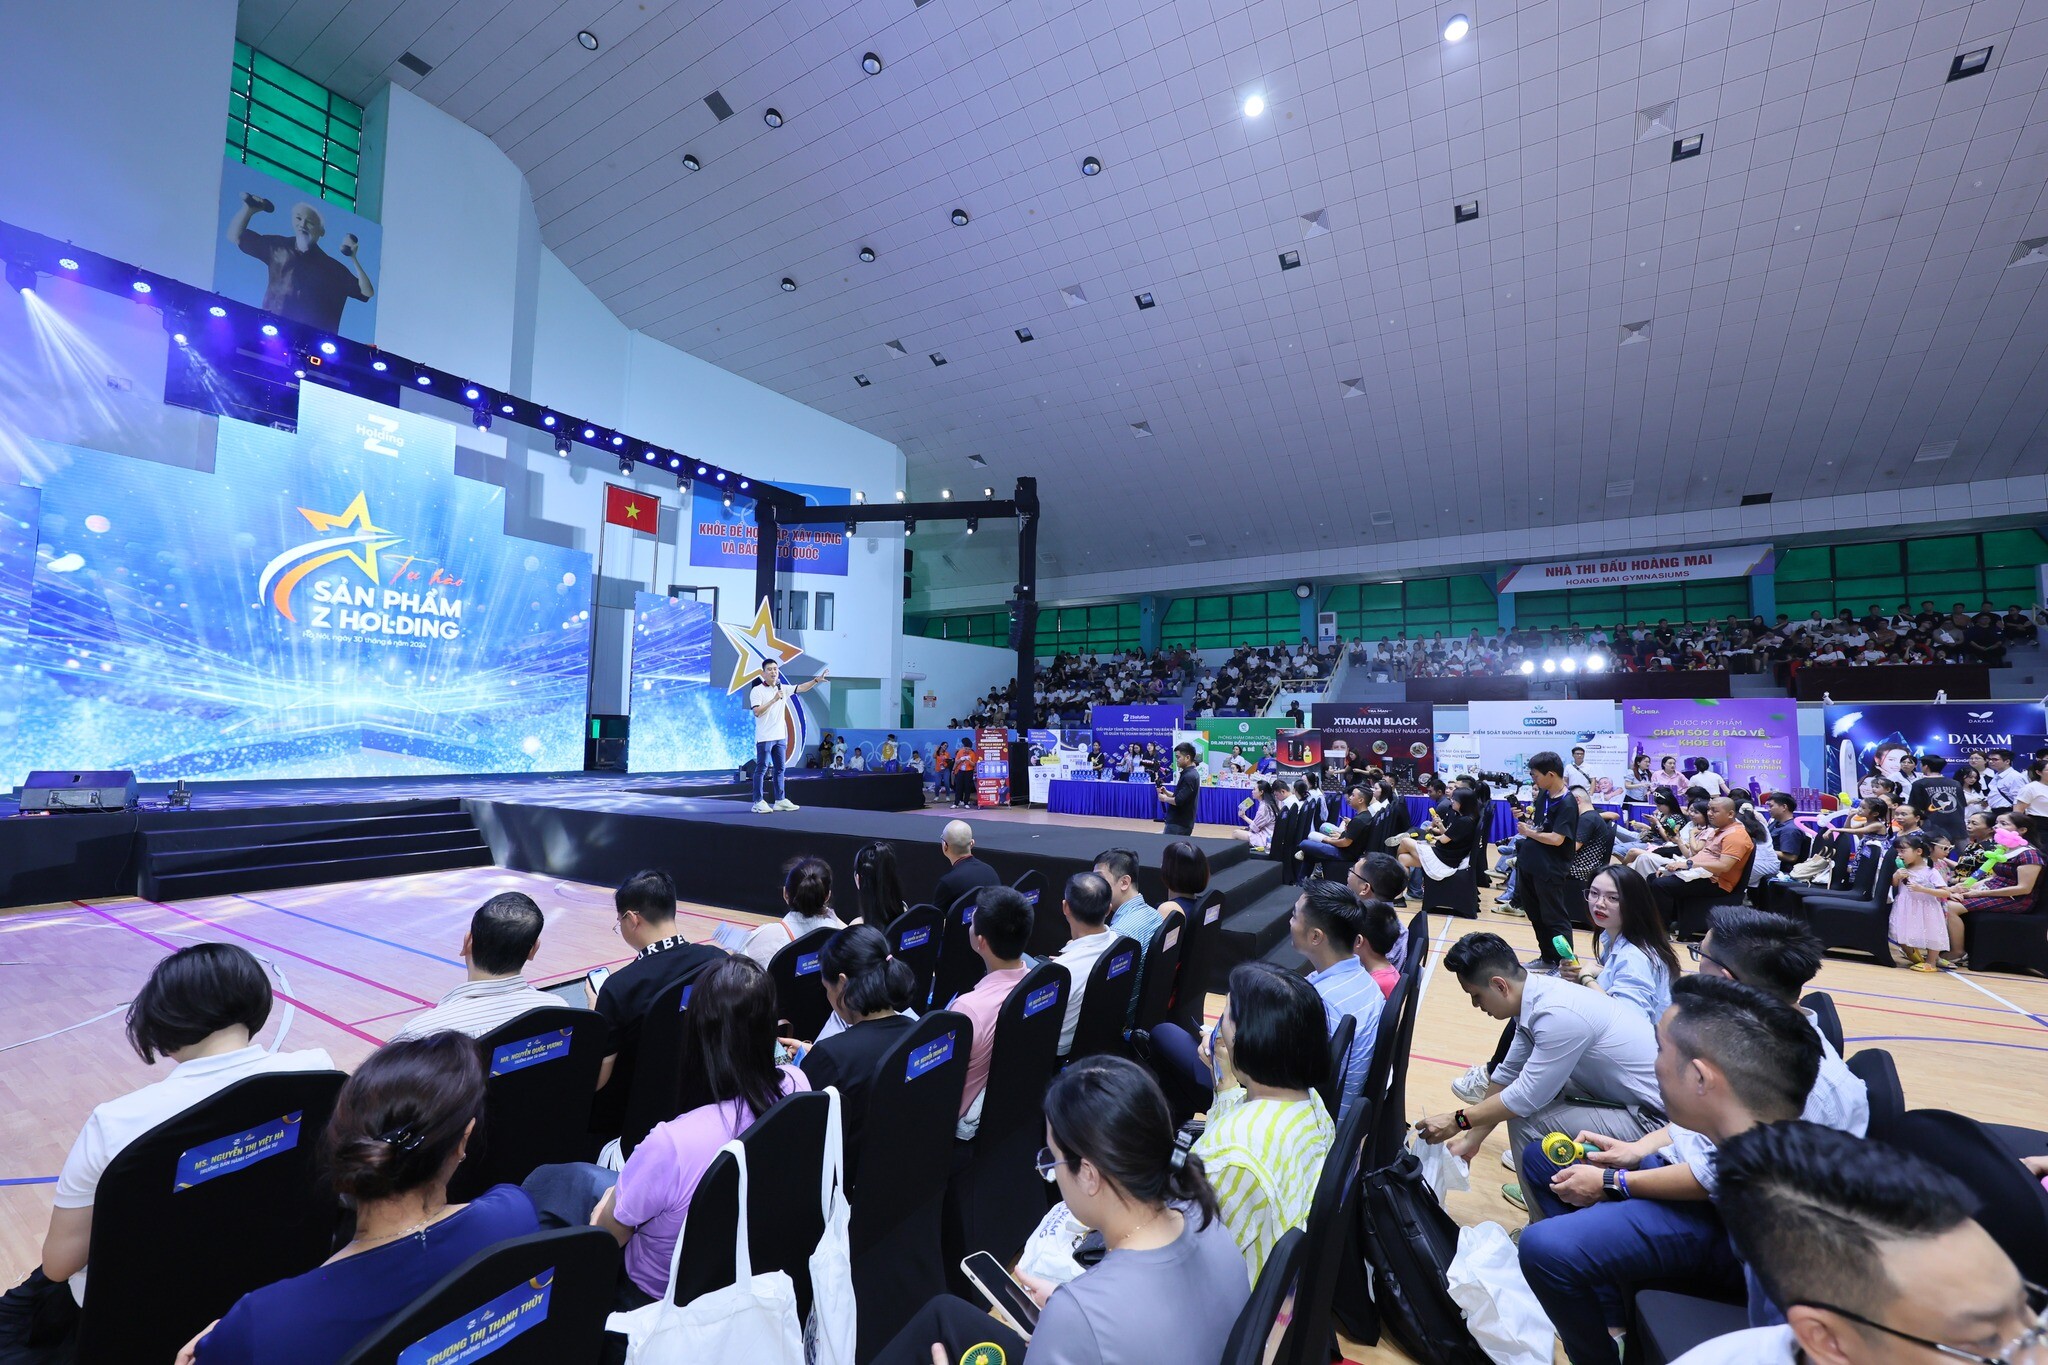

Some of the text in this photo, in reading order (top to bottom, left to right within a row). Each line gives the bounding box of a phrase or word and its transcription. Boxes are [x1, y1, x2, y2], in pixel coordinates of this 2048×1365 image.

[355, 422, 405, 448] Holding
[699, 520, 726, 536] KHỎE
[729, 521, 743, 537] ĐỂ
[745, 526, 758, 539] HỌ
[792, 528, 811, 542] XÂY
[814, 531, 842, 547] DỰNG
[721, 538, 735, 554] VÀ
[777, 542, 790, 558] TỔ
[792, 543, 819, 560] QUỐC
[1546, 553, 1713, 577] NHÀ THI ĐẤU HOÀNG MAI
[1566, 570, 1690, 585] HOANG MAI GYMNASIUMS
[313, 576, 462, 618] SẢN PHẨM
[311, 606, 460, 639] Z HOLDING
[332, 634, 352, 644] ngày
[353, 635, 363, 643] 30
[364, 636, 387, 646] tháng
[410, 641, 427, 649] 2024
[1333, 717, 1418, 726] XTRAMAN BLACK
[1653, 728, 1685, 736] CHĂM
[1687, 727, 1710, 736] SÓC
[1722, 727, 1747, 736] BẢO
[1701, 718, 1714, 726] MỸ
[1948, 733, 2014, 745] DAKAM
[194, 1129, 285, 1170] MS. NGUYỄN THỊ VIỆT HÀ
[470, 1326, 486, 1344] THỊ
[488, 1308, 519, 1333] THANH
[520, 1293, 544, 1314] THỦY
